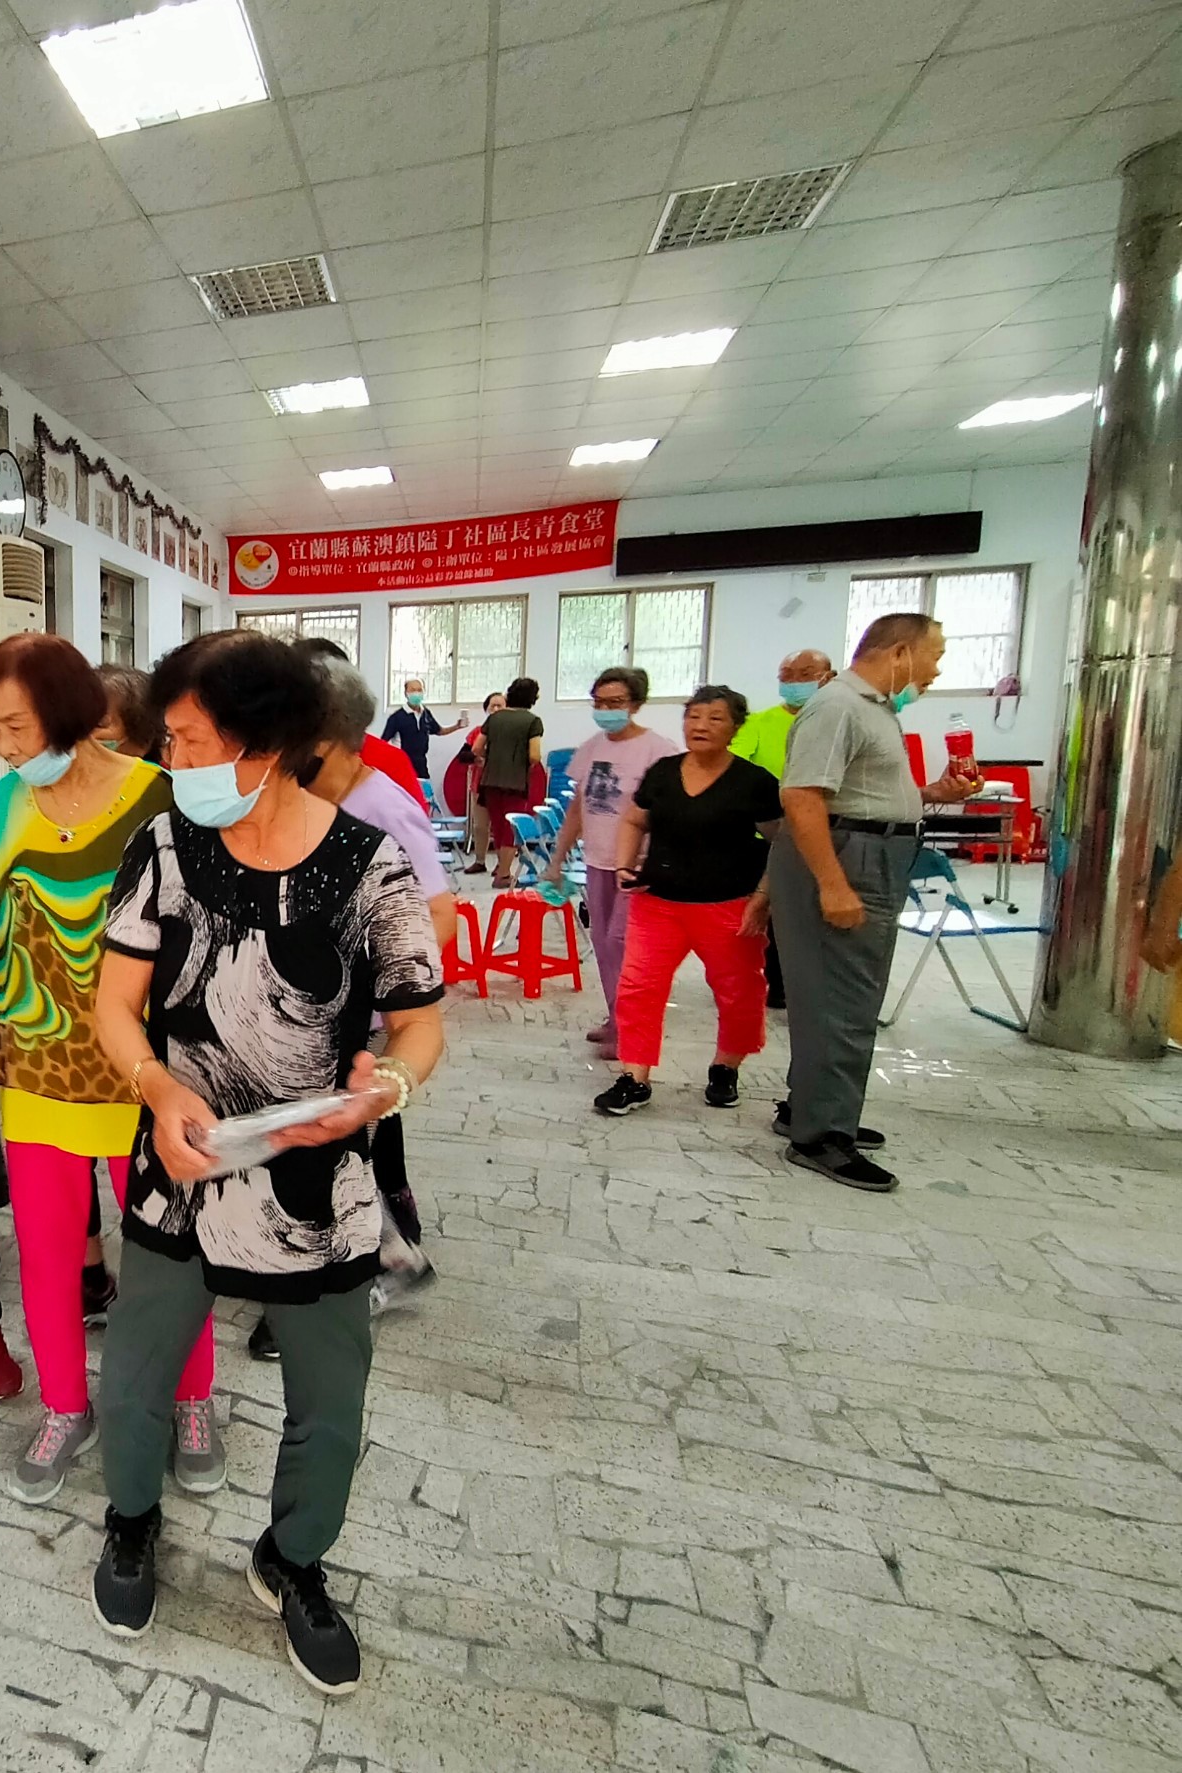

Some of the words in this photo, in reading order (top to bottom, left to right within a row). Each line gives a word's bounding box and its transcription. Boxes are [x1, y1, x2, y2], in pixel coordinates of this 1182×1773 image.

[288, 507, 605, 560] 宜蘭縣蘇澳鎮隘丁社區長青食堂
